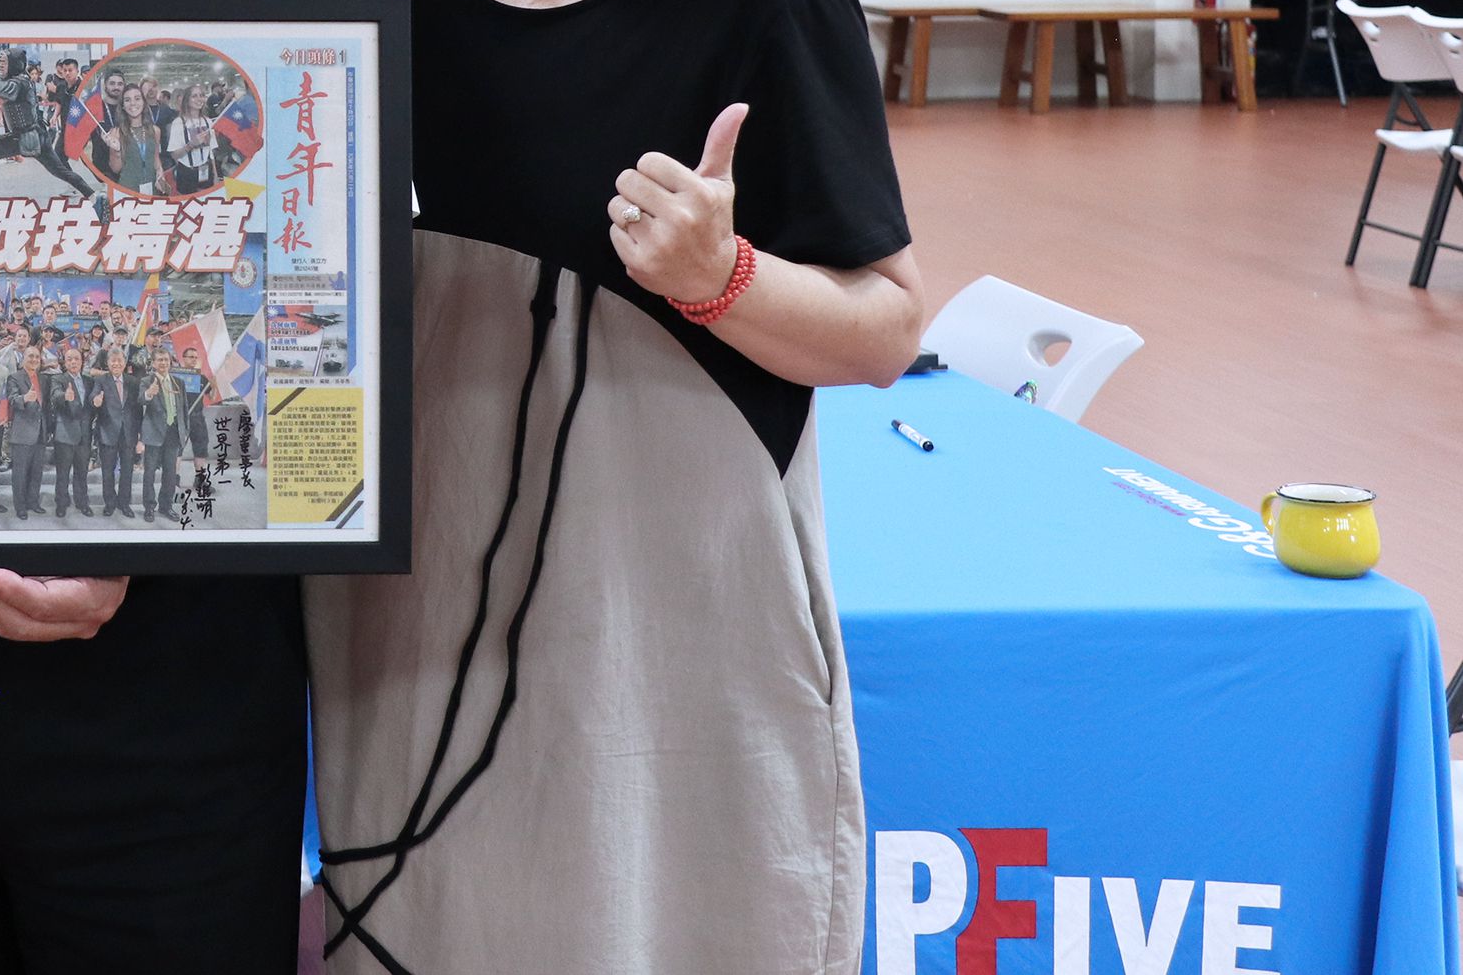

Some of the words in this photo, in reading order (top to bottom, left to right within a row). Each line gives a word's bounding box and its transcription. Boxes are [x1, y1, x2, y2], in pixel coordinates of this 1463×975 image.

[280, 47, 336, 66] 今日頭條
[273, 71, 333, 255] 青年日報
